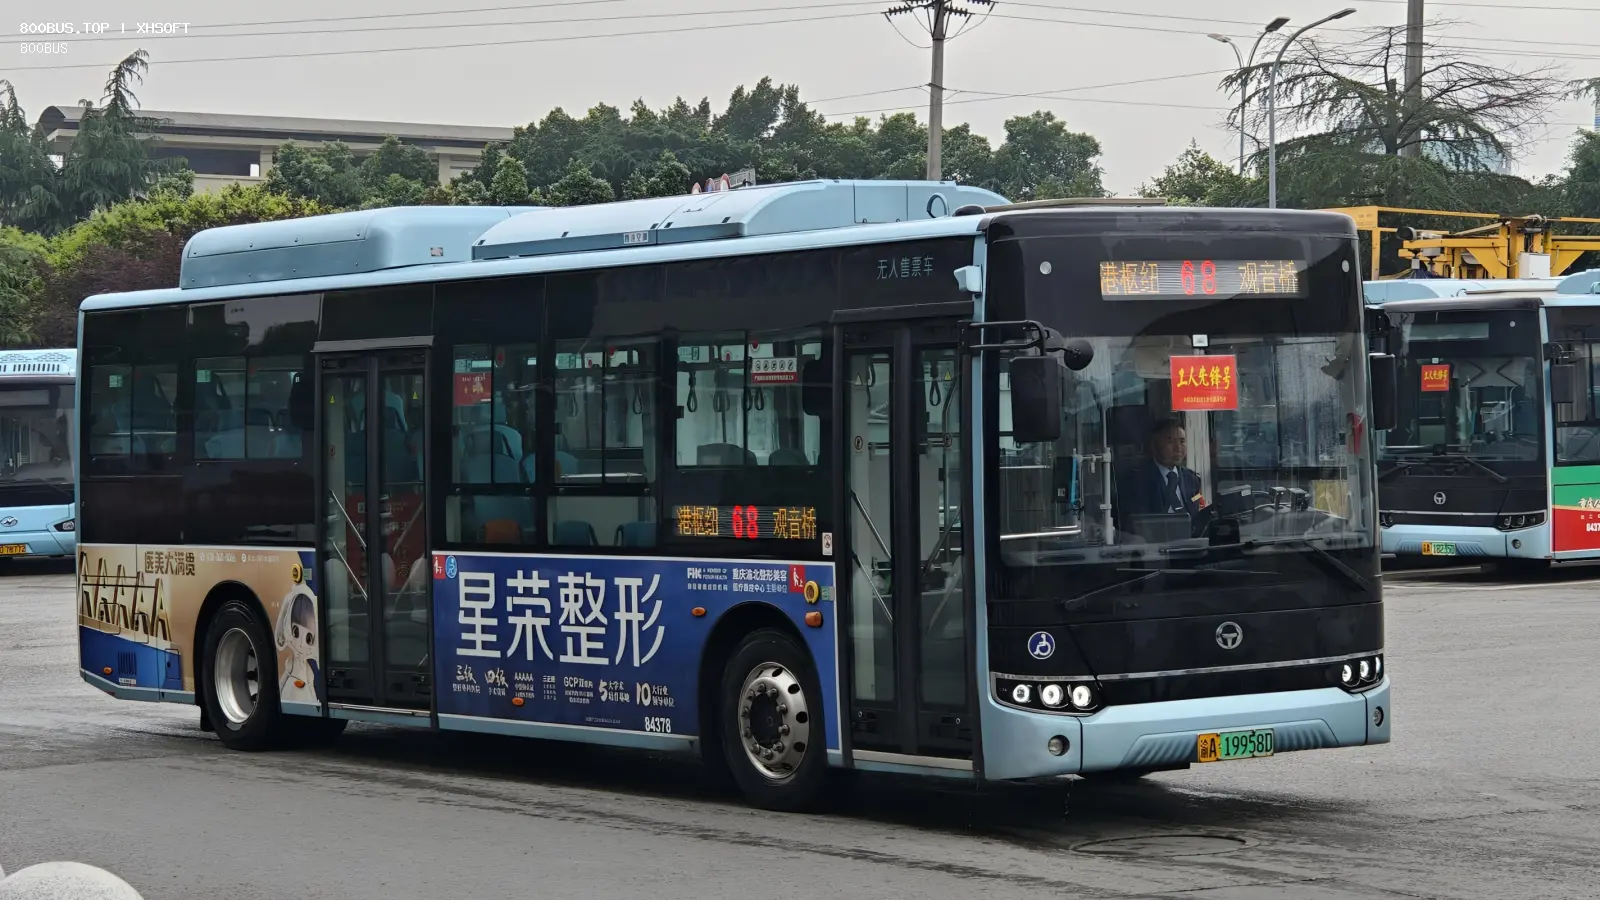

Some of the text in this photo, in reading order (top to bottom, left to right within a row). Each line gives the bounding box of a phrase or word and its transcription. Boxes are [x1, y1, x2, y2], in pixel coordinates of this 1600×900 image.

[877, 255, 934, 279] 无人售票车
[1100, 260, 1299, 295] 港枢纽 68 观音桥
[1177, 365, 1231, 389] 工人先锋号
[676, 505, 817, 539] 港枢纽 68 观音桥
[144, 551, 195, 576] 医美大满贯
[456, 570, 665, 667] 星荣整形
[645, 716, 671, 733] 84378
